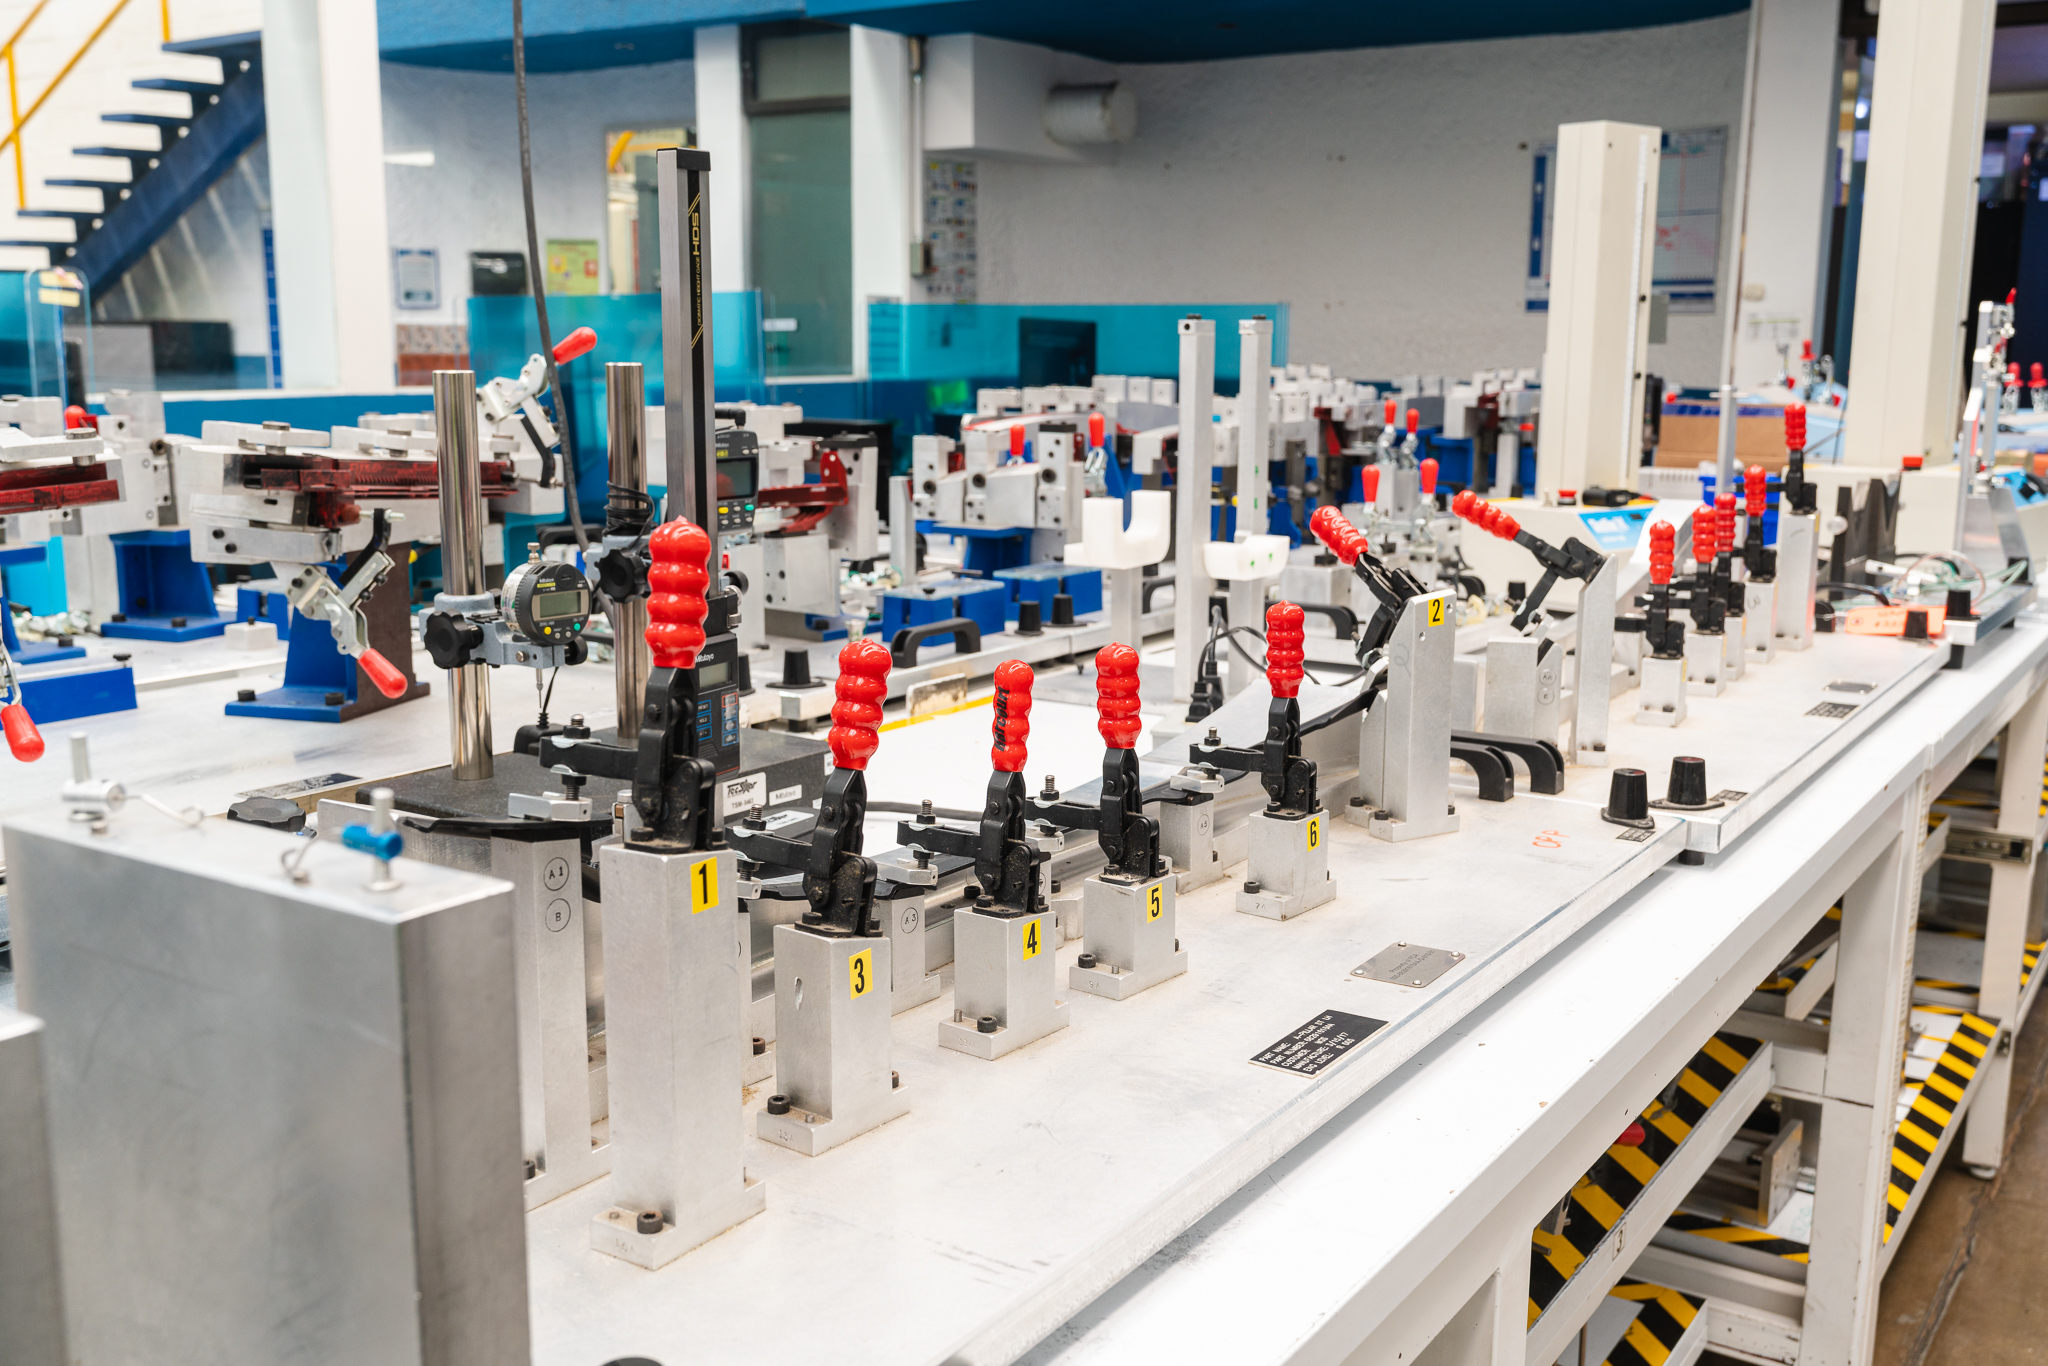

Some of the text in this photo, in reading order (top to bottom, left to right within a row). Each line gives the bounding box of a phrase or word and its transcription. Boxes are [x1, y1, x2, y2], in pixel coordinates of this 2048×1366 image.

[1432, 598, 1441, 623] 2
[1309, 820, 1317, 848] 6
[698, 863, 708, 905] 1
[555, 911, 562, 922] B
[1151, 887, 1160, 918] 5
[1026, 922, 1038, 955] 4
[853, 957, 866, 994] 3
[1258, 1052, 1276, 1062] PART
[1269, 1054, 1287, 1065] PART
